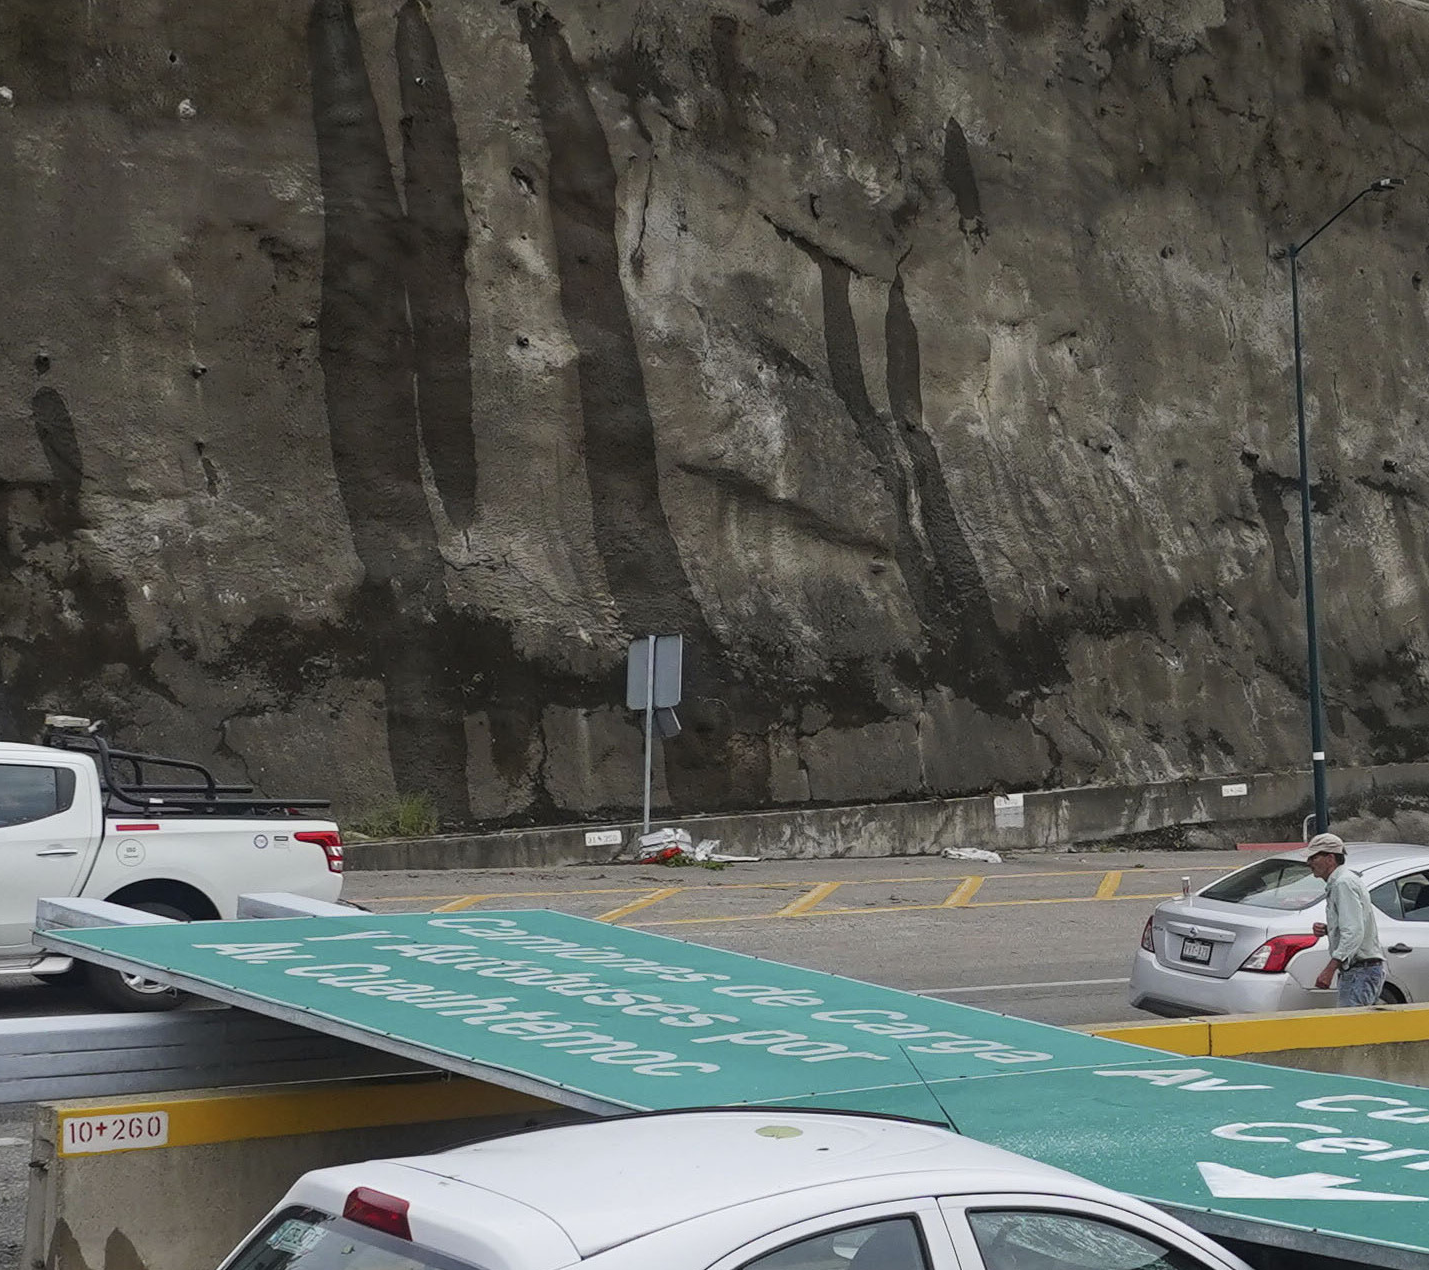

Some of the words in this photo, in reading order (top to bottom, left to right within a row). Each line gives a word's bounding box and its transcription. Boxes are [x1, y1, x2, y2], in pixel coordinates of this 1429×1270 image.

[191, 942, 317, 964] Av.
[284, 963, 721, 1077] Cuauhtémoc
[303, 930, 411, 942] y
[373, 943, 741, 1028] Autobuses
[690, 1029, 891, 1063] por
[427, 917, 731, 983] Camiones
[712, 984, 825, 1008] de
[811, 1009, 1054, 1064] Carga
[69, 1116, 161, 1144] 10+260
[1092, 1068, 1275, 1092] Av
